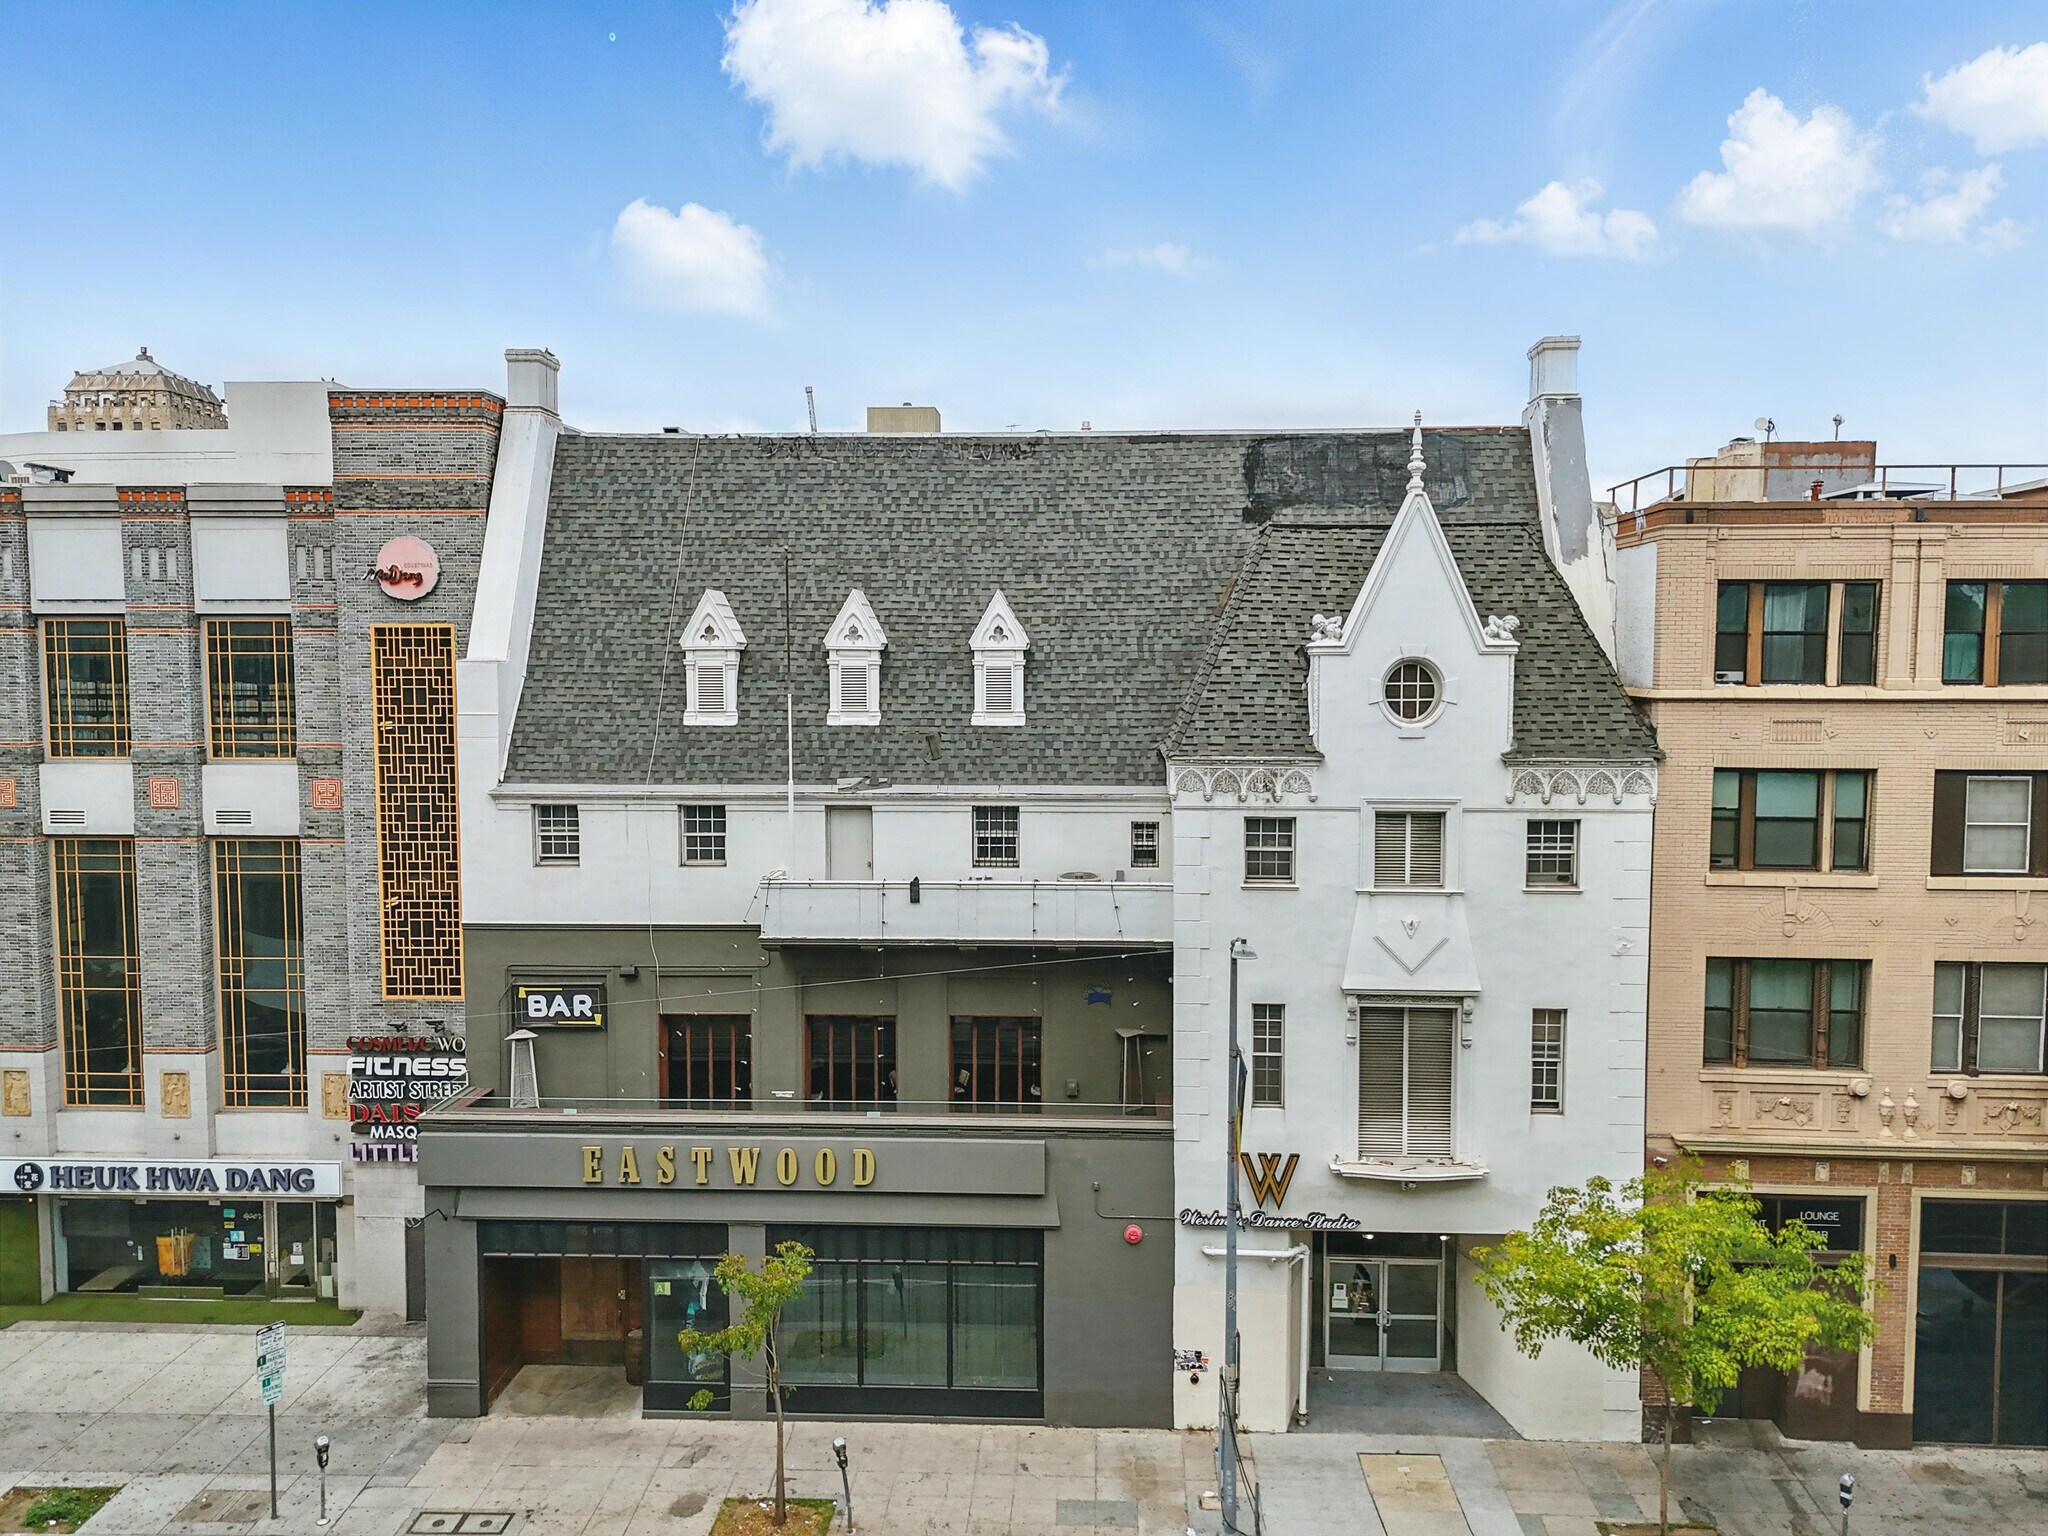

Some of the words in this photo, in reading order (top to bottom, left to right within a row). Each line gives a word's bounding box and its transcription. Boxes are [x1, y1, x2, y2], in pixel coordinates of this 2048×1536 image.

[527, 994, 593, 1018] BAR
[346, 1056, 467, 1076] FITNESS
[348, 1080, 405, 1099] ARTIST
[349, 1103, 427, 1123] DAIS
[370, 1125, 418, 1140] MASQ
[582, 1146, 876, 1186] EASTWOOD
[50, 1165, 140, 1191] HEUK
[145, 1166, 219, 1192] HWA
[225, 1167, 315, 1192] DANG
[1179, 1208, 1249, 1228] Westmr
[1249, 1210, 1303, 1229] Dance
[1303, 1211, 1361, 1231] Studio
[1800, 1210, 1840, 1222] LOUNGE
[656, 1284, 664, 1293] A
